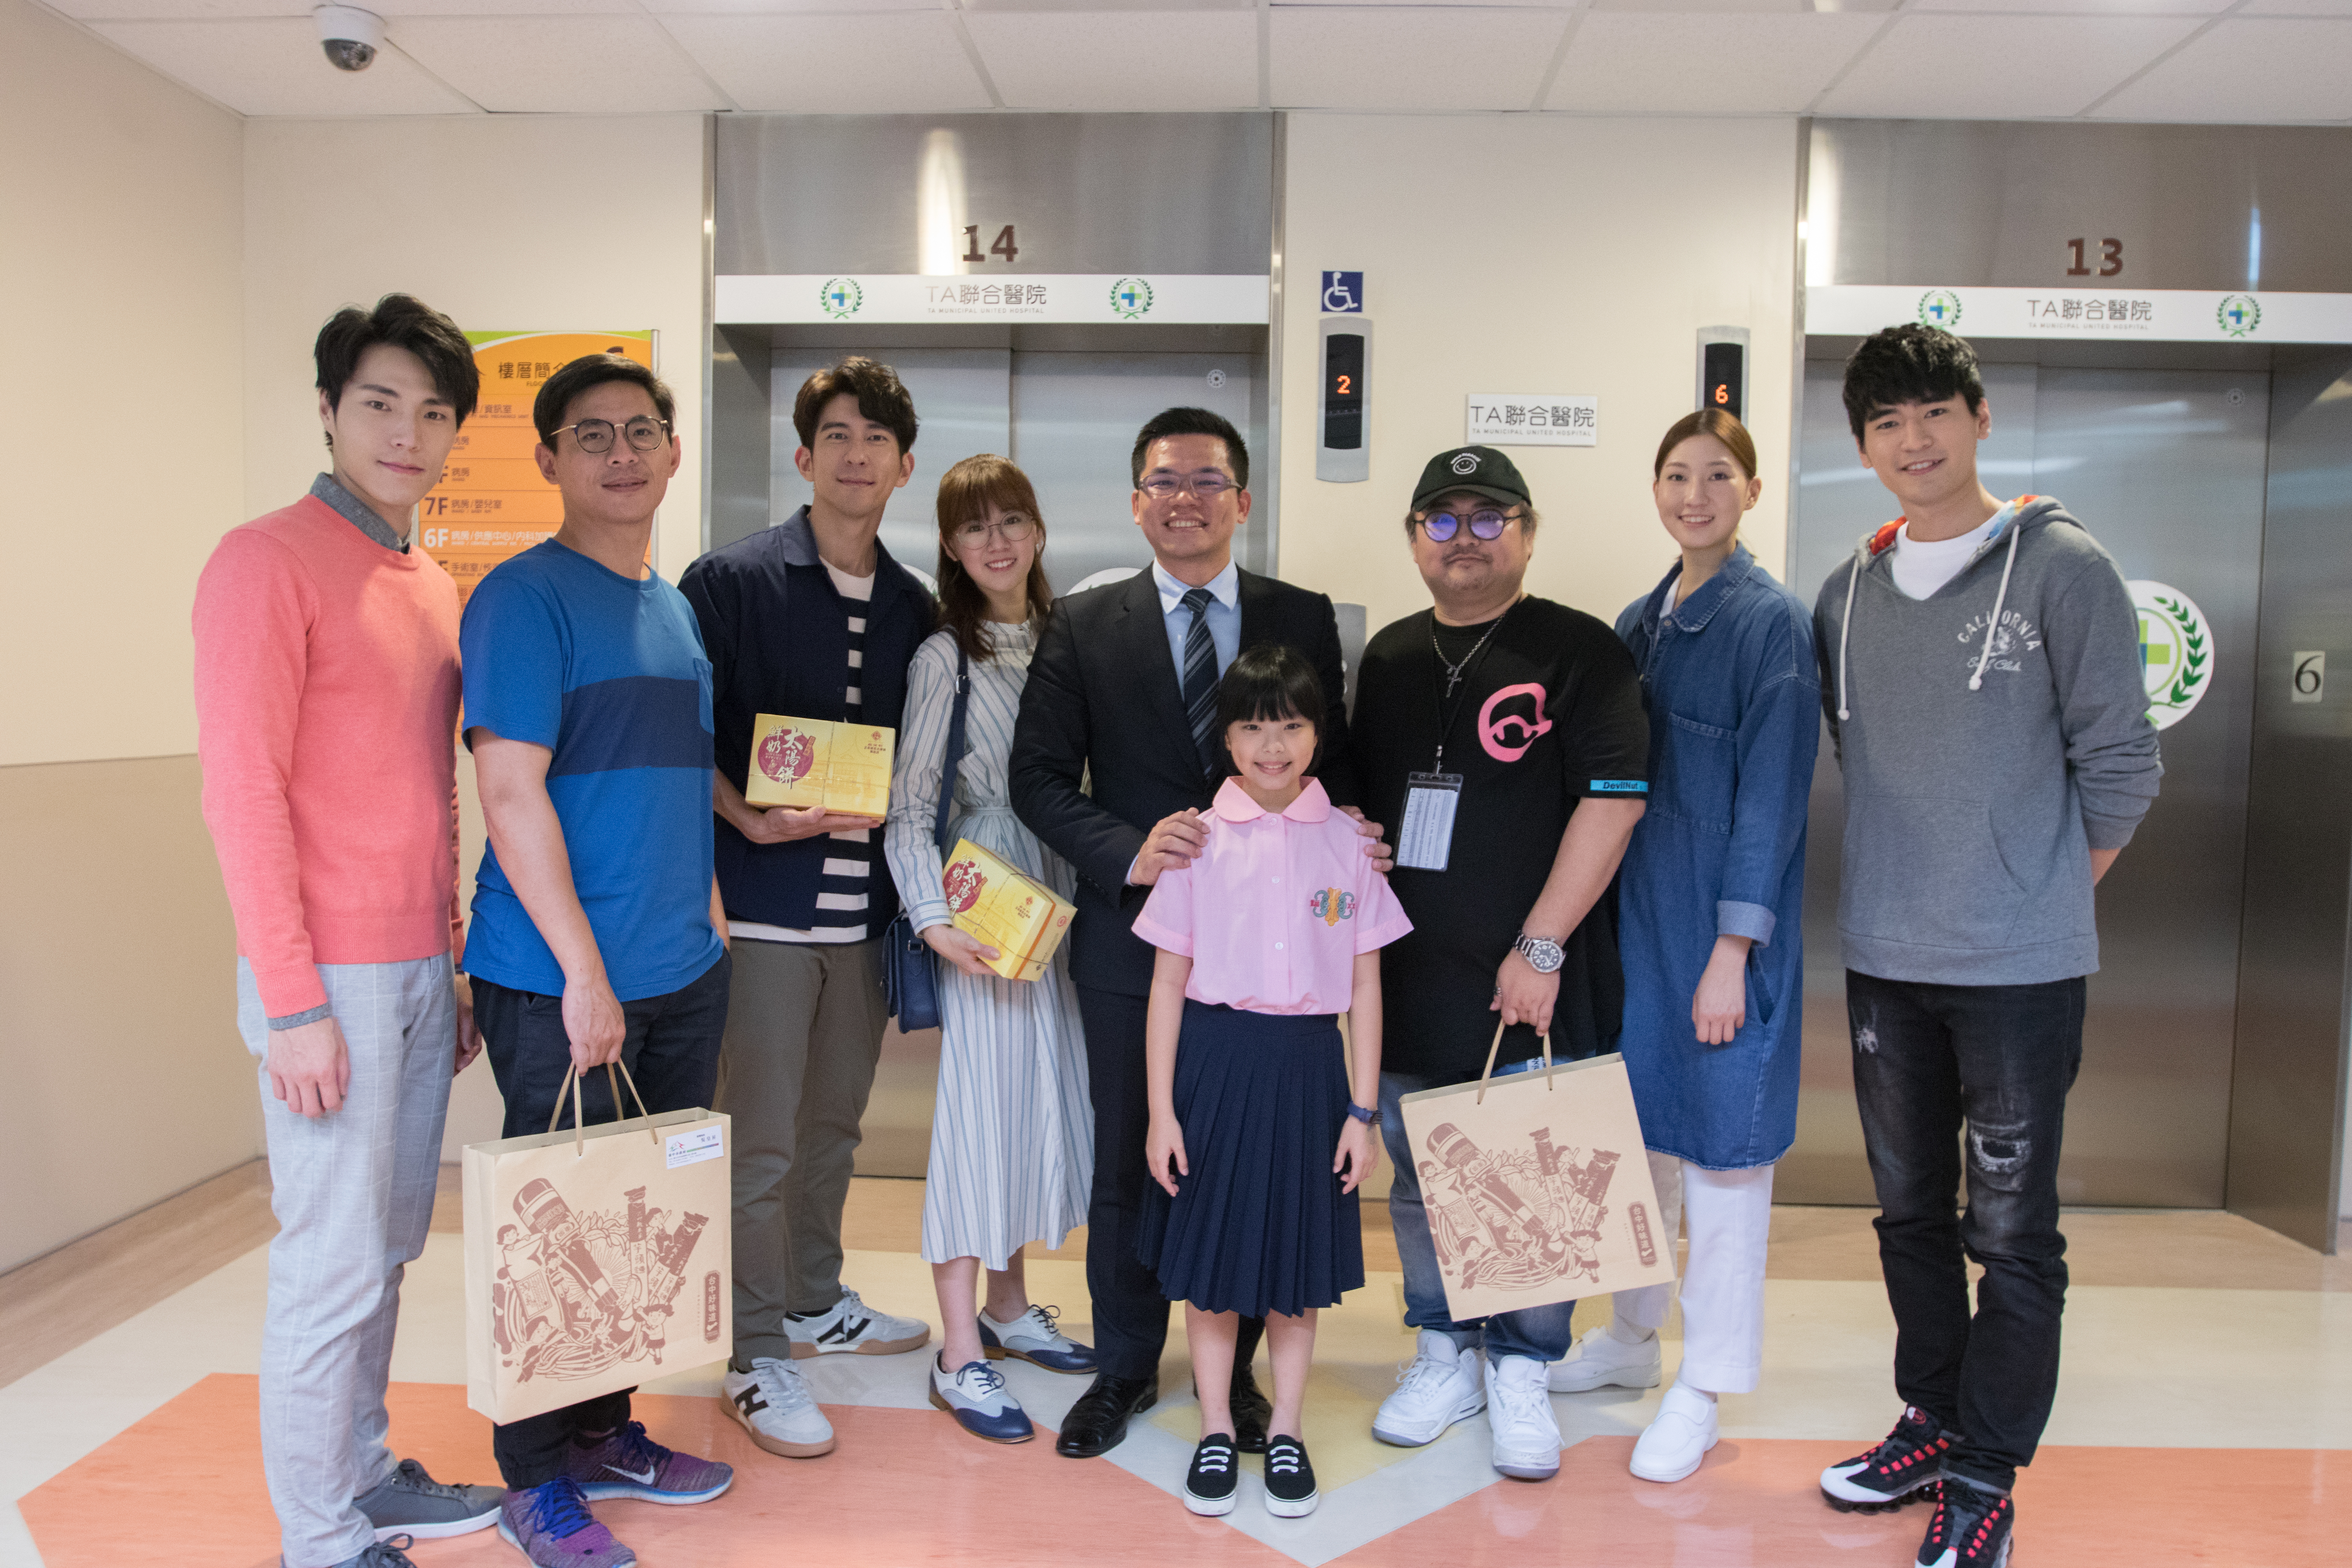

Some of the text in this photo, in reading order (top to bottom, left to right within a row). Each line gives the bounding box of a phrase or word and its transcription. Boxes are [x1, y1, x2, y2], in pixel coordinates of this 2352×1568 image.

[962, 225, 1018, 261] 14
[2067, 238, 2123, 276] 13
[926, 285, 1046, 304] TA聯合醫院
[2027, 299, 2152, 320] TA聯合醫院
[1337, 375, 1350, 394] 2
[1715, 384, 1728, 404] 6
[1470, 405, 1594, 427] TA聯合醫院
[425, 497, 448, 515] 7F
[424, 528, 448, 547] 6F
[1957, 610, 2041, 651] CALIORNIA
[2295, 655, 2322, 695] 6
[776, 726, 804, 789] 太陽餅
